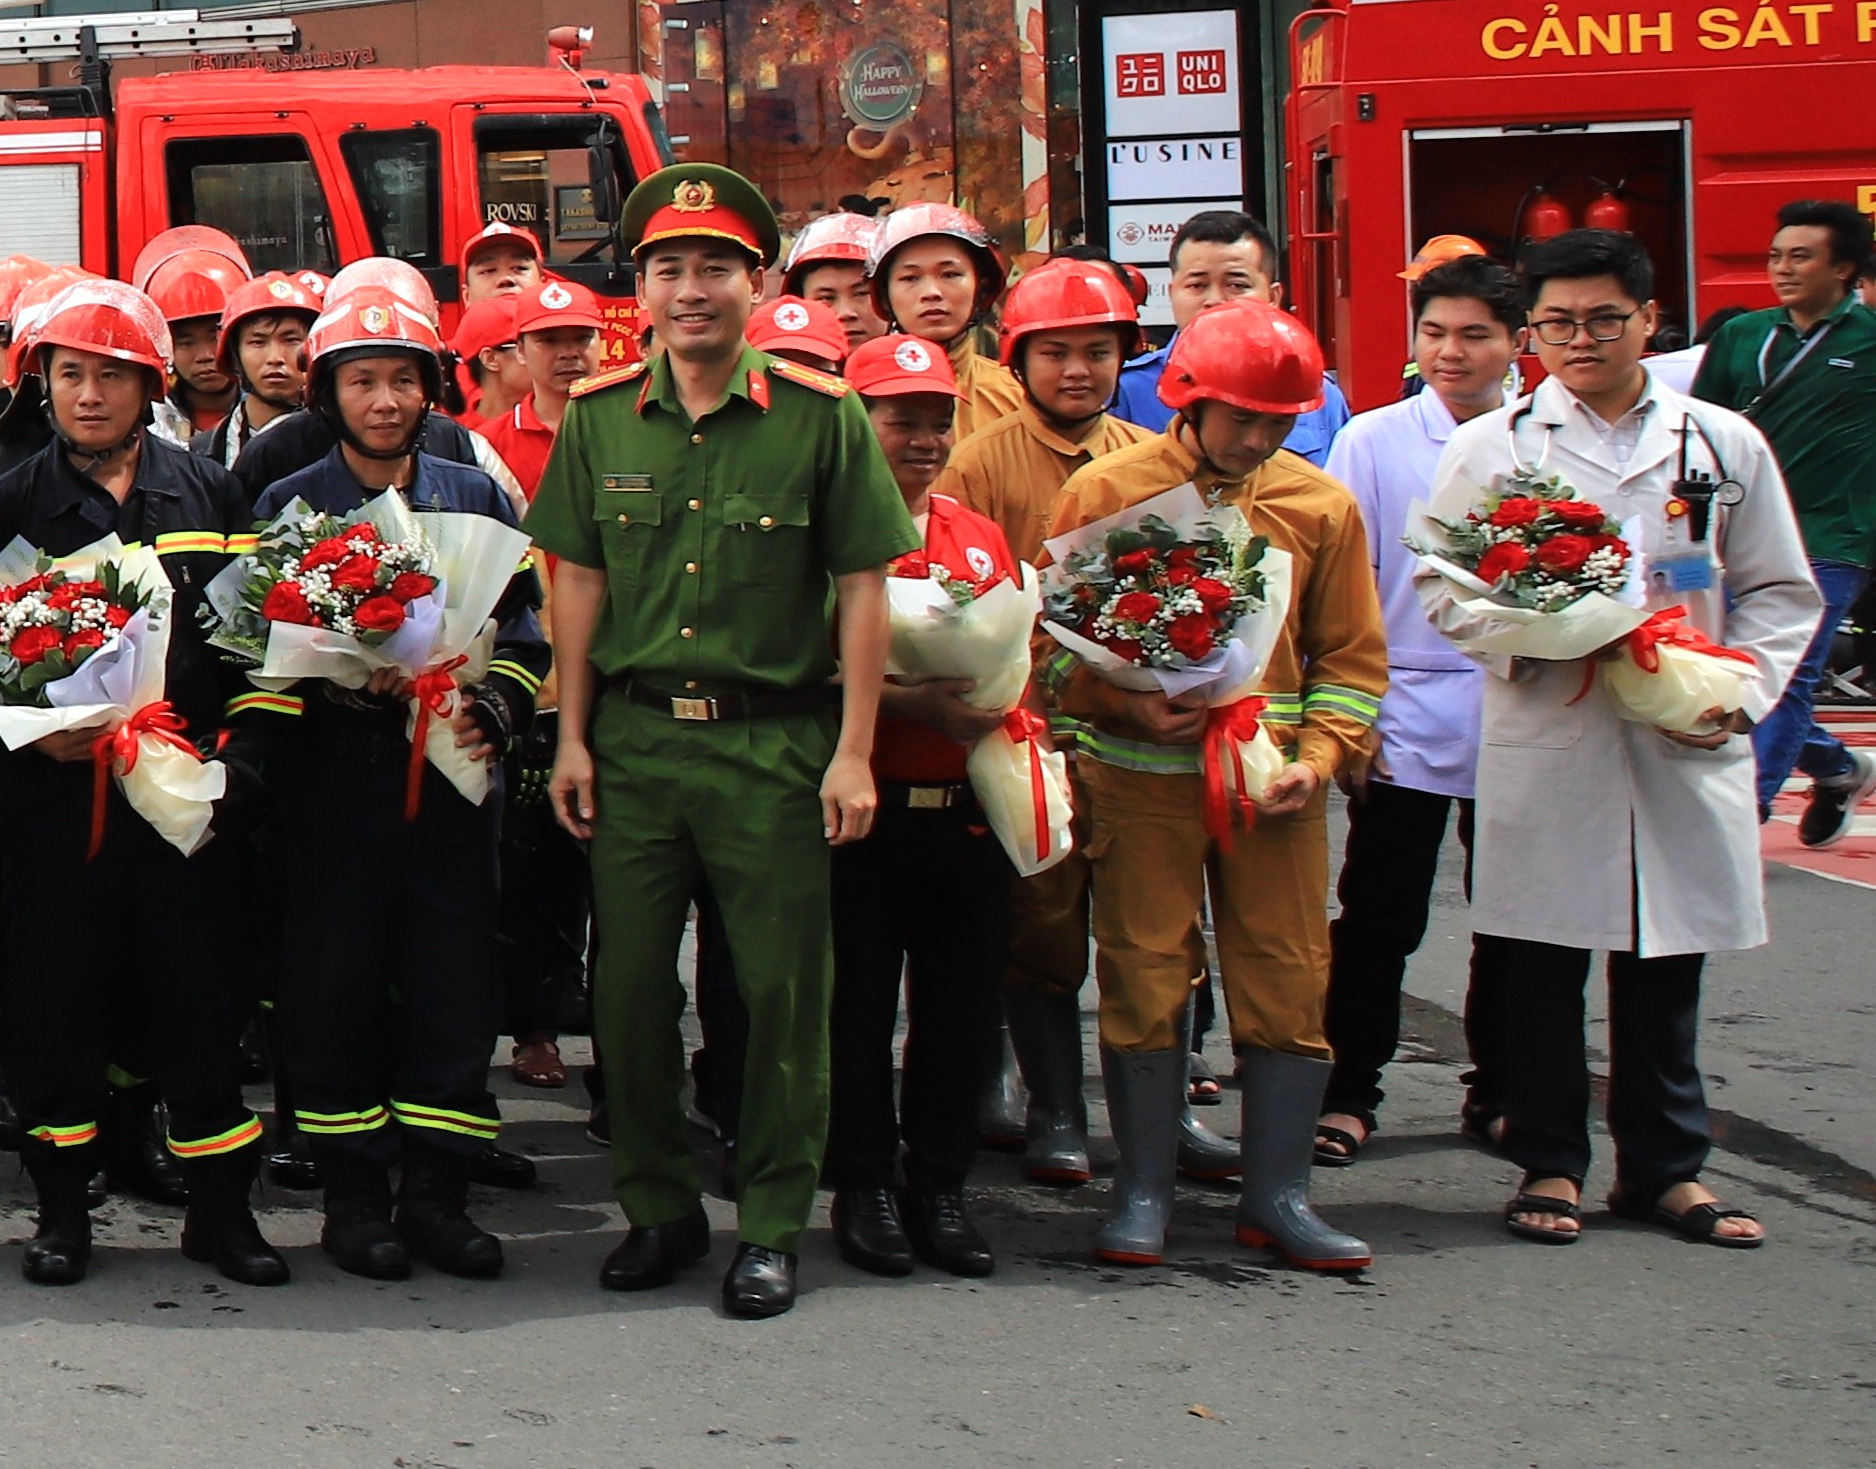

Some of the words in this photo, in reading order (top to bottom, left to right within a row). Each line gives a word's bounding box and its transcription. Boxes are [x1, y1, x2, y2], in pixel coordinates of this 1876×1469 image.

[1481, 4, 1673, 60] CẢNH
[861, 63, 902, 82] HAPPY
[1181, 55, 1218, 72] UNI
[1182, 73, 1222, 92] QLO
[1111, 141, 1237, 164] L'USINE
[486, 203, 537, 222] ROVSKI
